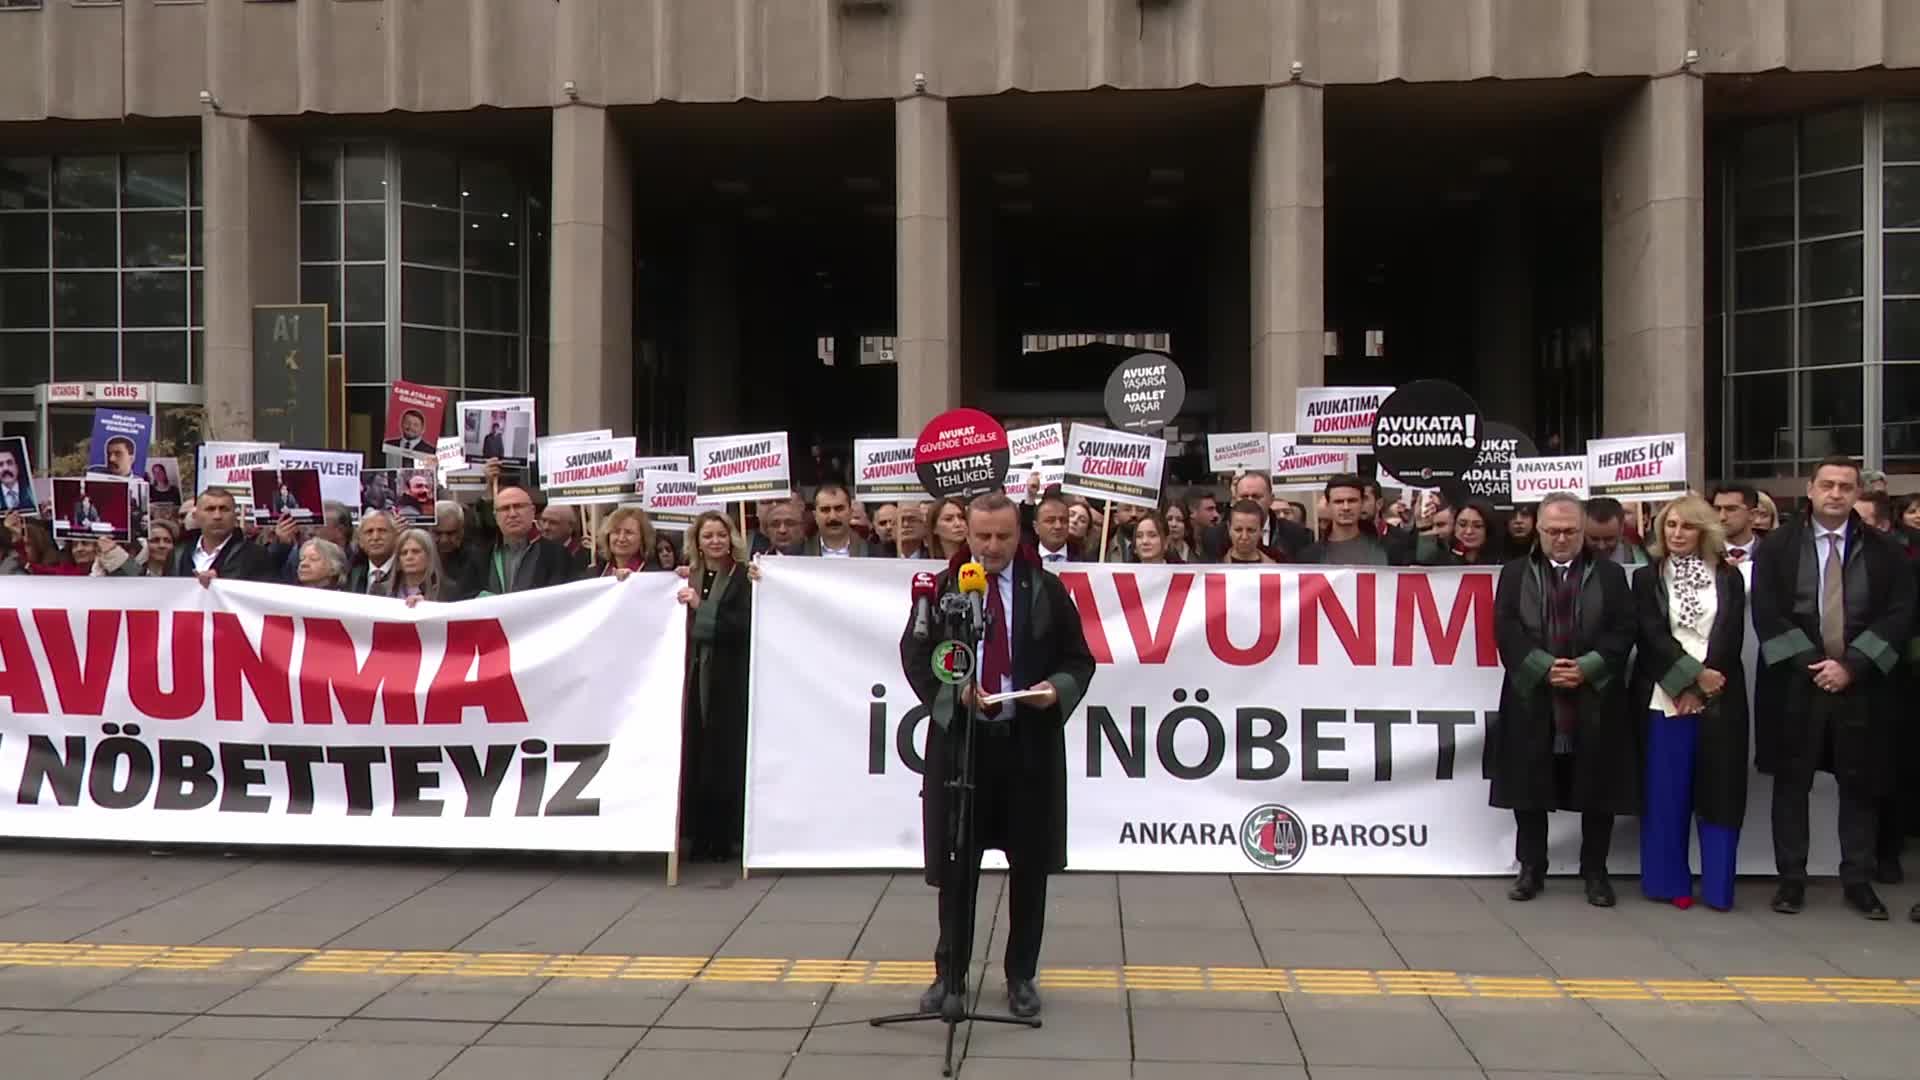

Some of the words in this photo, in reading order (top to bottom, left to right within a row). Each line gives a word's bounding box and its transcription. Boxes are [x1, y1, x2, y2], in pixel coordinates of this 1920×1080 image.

[1123, 365, 1167, 379] AVUKAT
[1123, 376, 1167, 390] YAŞARSA
[1123, 390, 1166, 403] ADALET
[1307, 395, 1379, 417] AVUKATIMA
[1128, 401, 1161, 414] YAŞAR
[1313, 413, 1377, 433] DOKUNMA
[1377, 416, 1464, 431] AVUKATA
[939, 426, 975, 440] AVUKAT
[1011, 427, 1057, 449] AVUKATA
[708, 440, 771, 464] SAVUNMAYI
[920, 439, 961, 454] GÜVENDE
[1077, 441, 1151, 460] SAVUNMAYA
[1599, 447, 1646, 468] HERKES
[1649, 441, 1674, 462] İÇİN
[216, 453, 236, 469] HAK
[238, 450, 270, 466] HUKUK
[565, 448, 612, 469] SAVUNMA
[703, 453, 781, 480] SAVUNUYORUZ
[933, 454, 992, 474] YURTTAŞ
[1082, 458, 1147, 477] ÖZGÜRLÜK
[1516, 461, 1583, 473] ANAYASAYI
[227, 467, 263, 483] ADAL
[553, 459, 628, 485] TUTUKLANAMAZ
[935, 468, 995, 488] TEHLİKEDE
[1462, 469, 1511, 481] ADALE
[1615, 461, 1663, 481] ADALET
[656, 481, 696, 494] SAVUNM
[1469, 482, 1509, 496] YAŞAR
[1516, 477, 1583, 492] UYGULA!
[17, 722, 611, 817] NÖBETTEYİZ
[1119, 822, 1237, 846] ANKARA
[1311, 823, 1428, 847] BAROSU
